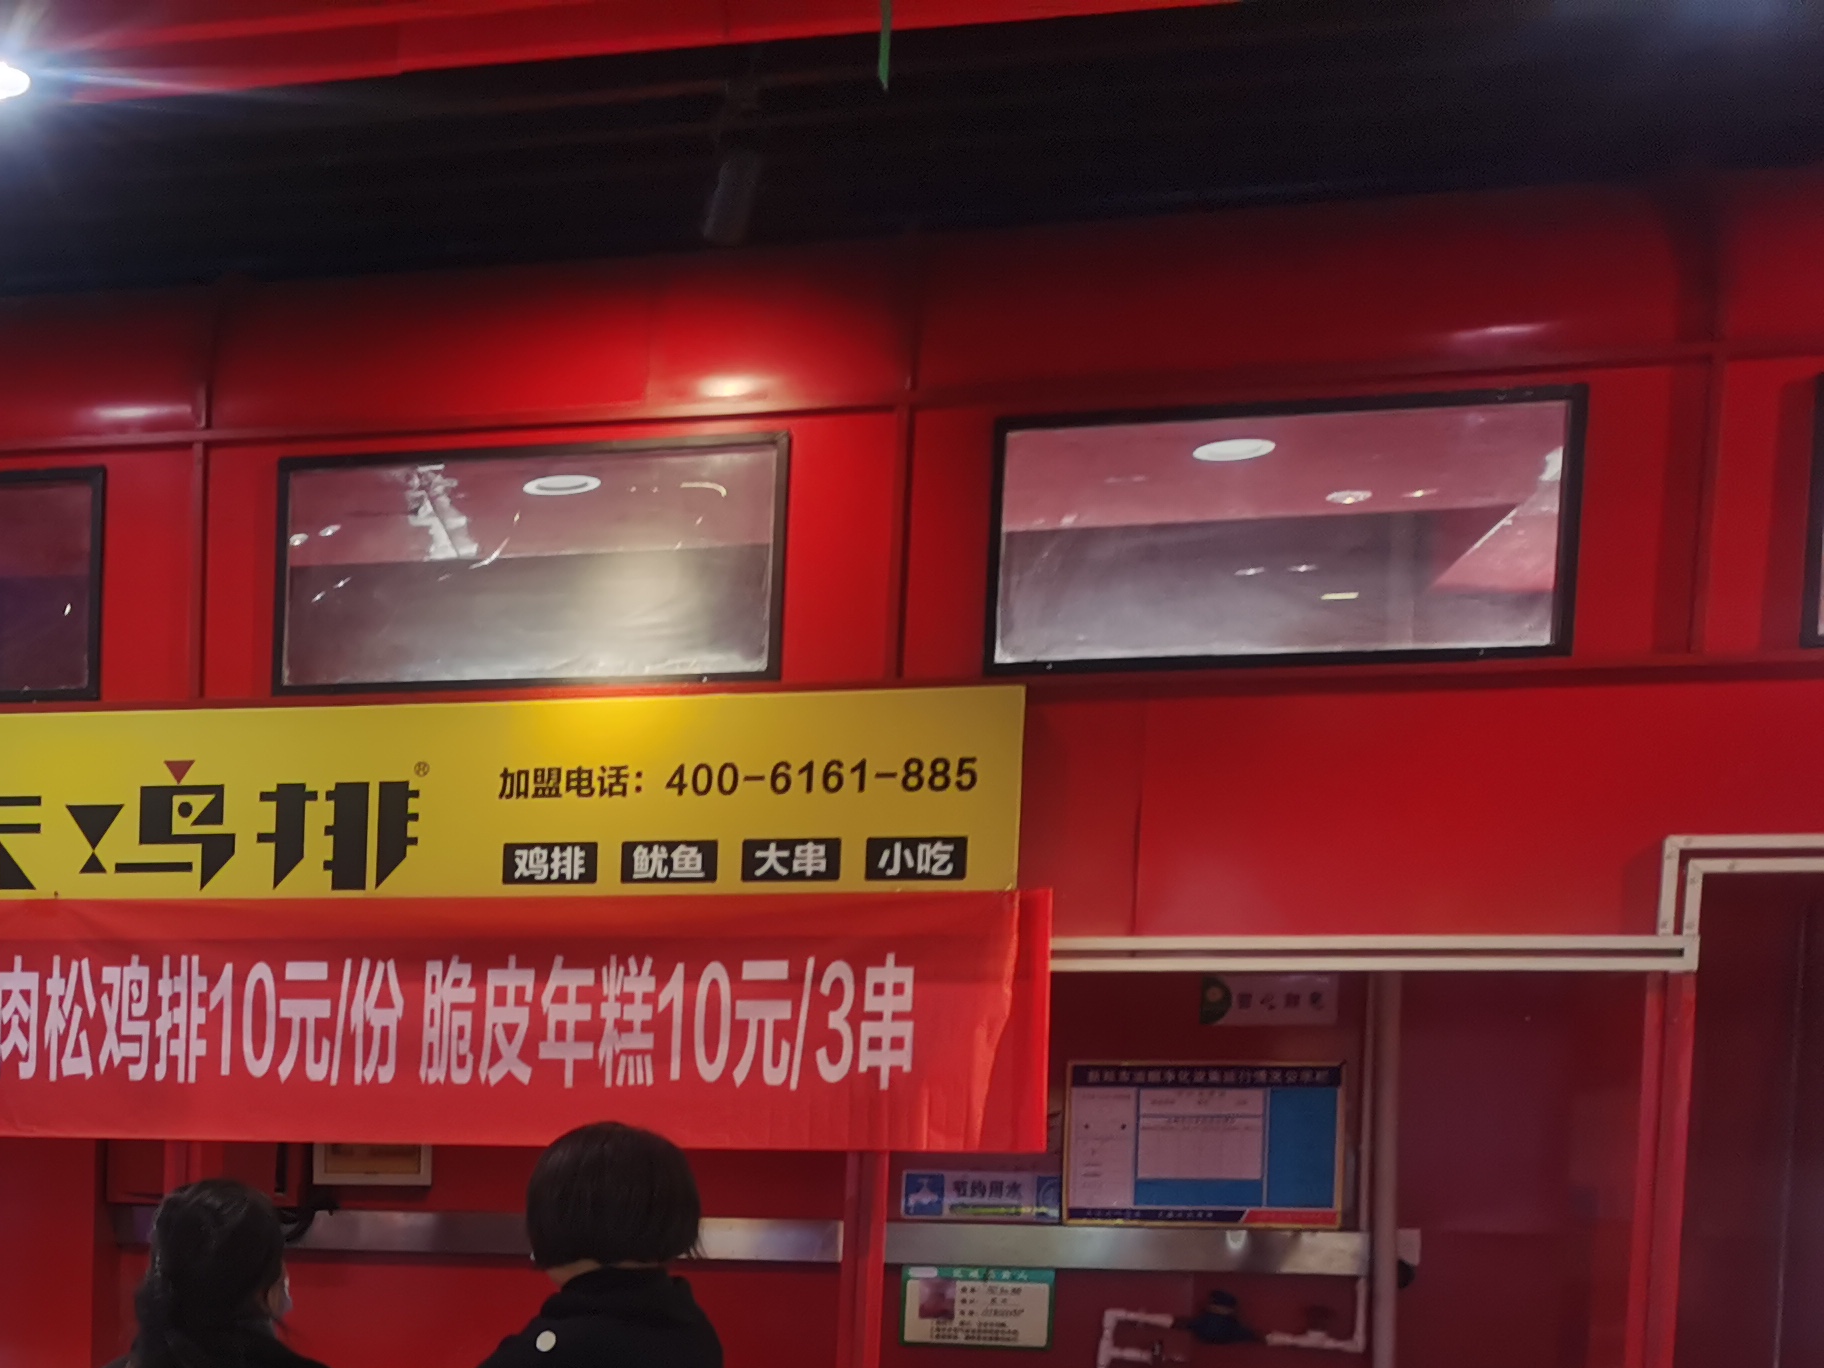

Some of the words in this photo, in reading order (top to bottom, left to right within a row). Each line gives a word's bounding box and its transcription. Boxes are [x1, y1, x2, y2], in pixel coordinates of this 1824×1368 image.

[514, 846, 586, 882] 鸡排
[631, 844, 706, 880] 鱿鱼
[753, 841, 829, 877] 大串
[877, 839, 955, 877] 小吃
[419, 953, 915, 1091] 脆皮年糕10元/3串
